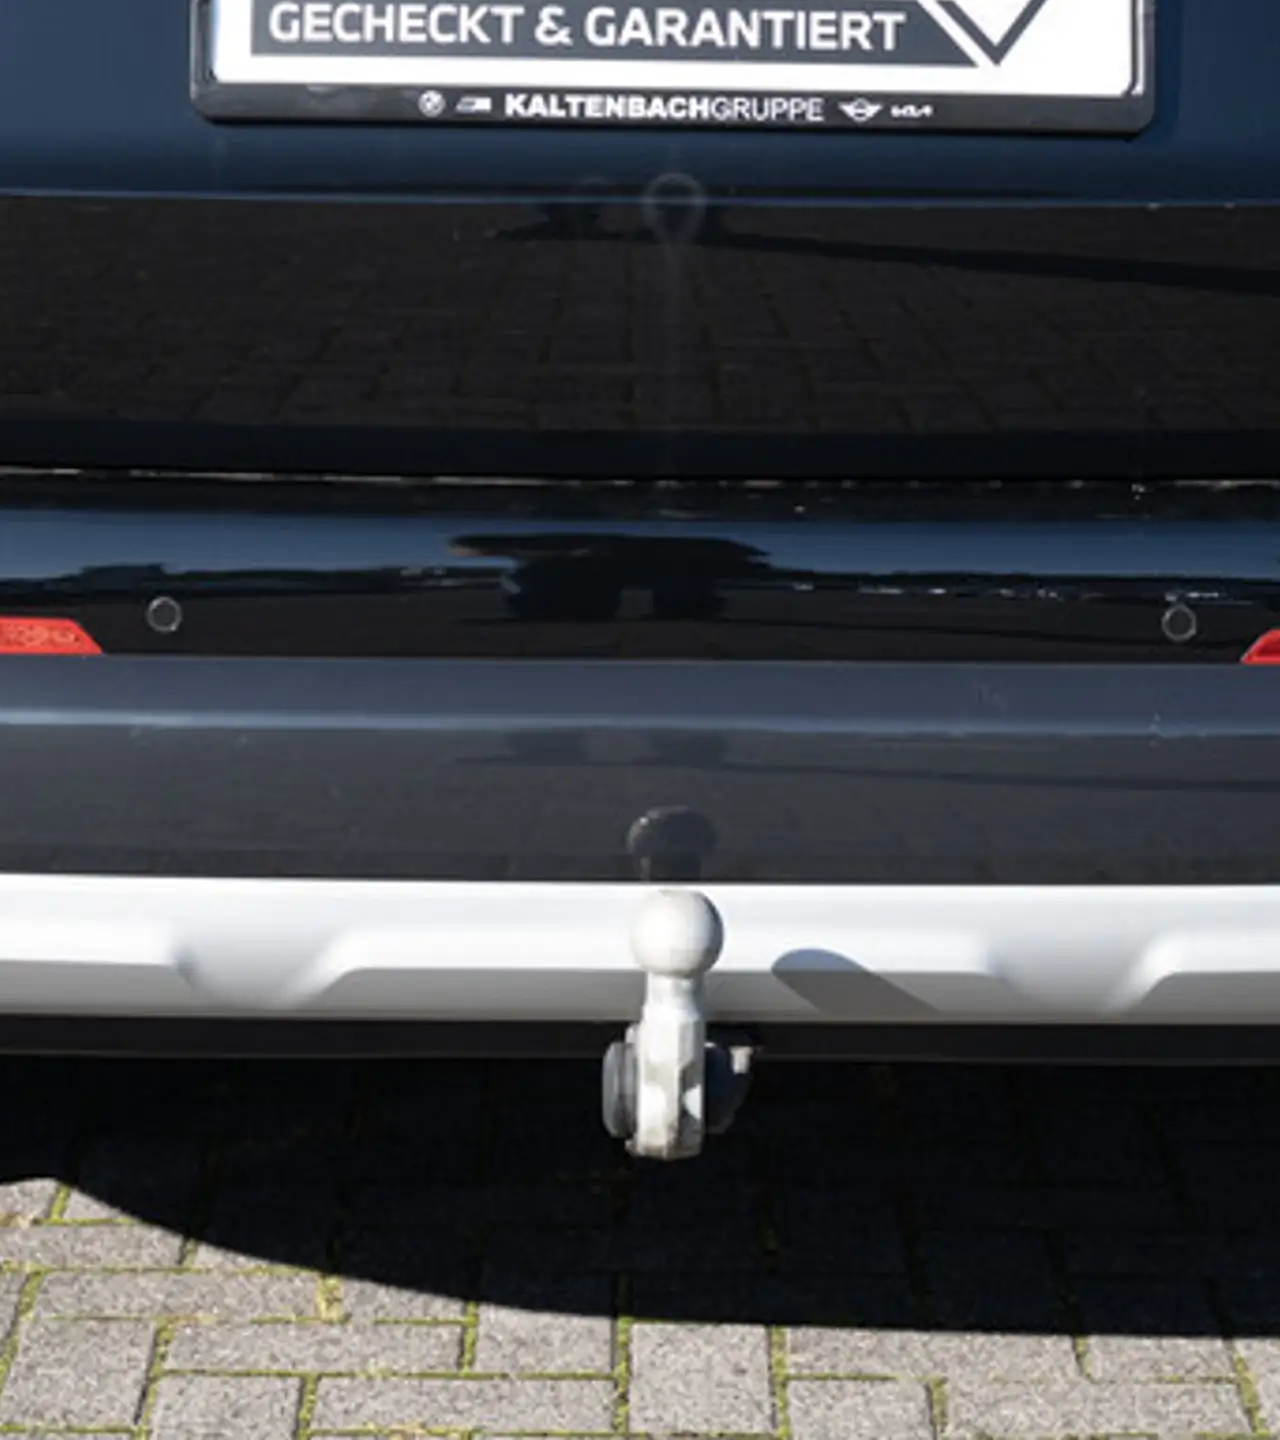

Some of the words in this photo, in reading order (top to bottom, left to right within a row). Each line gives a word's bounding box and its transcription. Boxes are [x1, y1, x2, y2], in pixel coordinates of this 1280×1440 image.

[268, 0, 524, 45] GECHECKT
[534, 5, 572, 46] &
[584, 6, 906, 51] GARANTIERT
